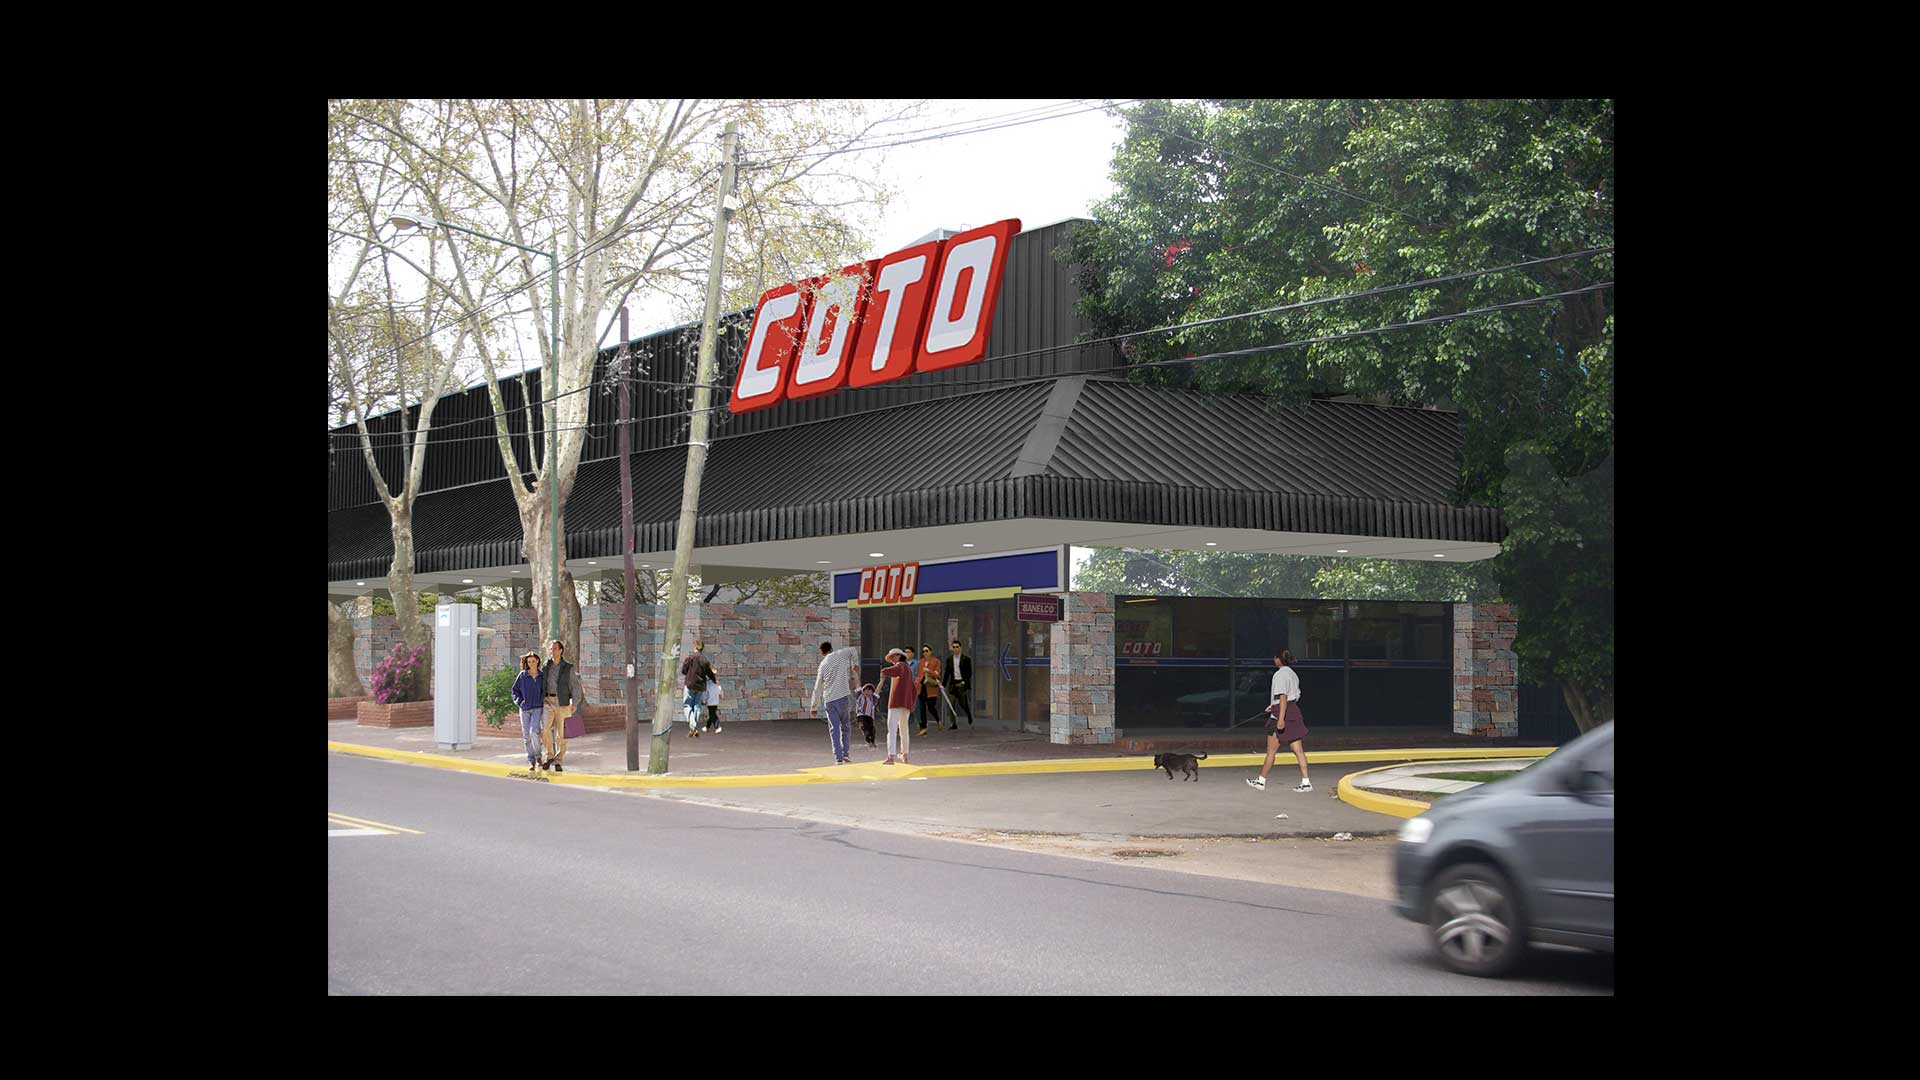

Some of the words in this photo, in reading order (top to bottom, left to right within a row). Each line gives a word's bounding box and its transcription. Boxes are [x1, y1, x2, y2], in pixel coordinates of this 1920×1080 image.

[735, 232, 999, 401] COTO
[858, 564, 917, 602] COTO
[1022, 604, 1055, 614] BANELCO
[1122, 641, 1162, 655] COTO
